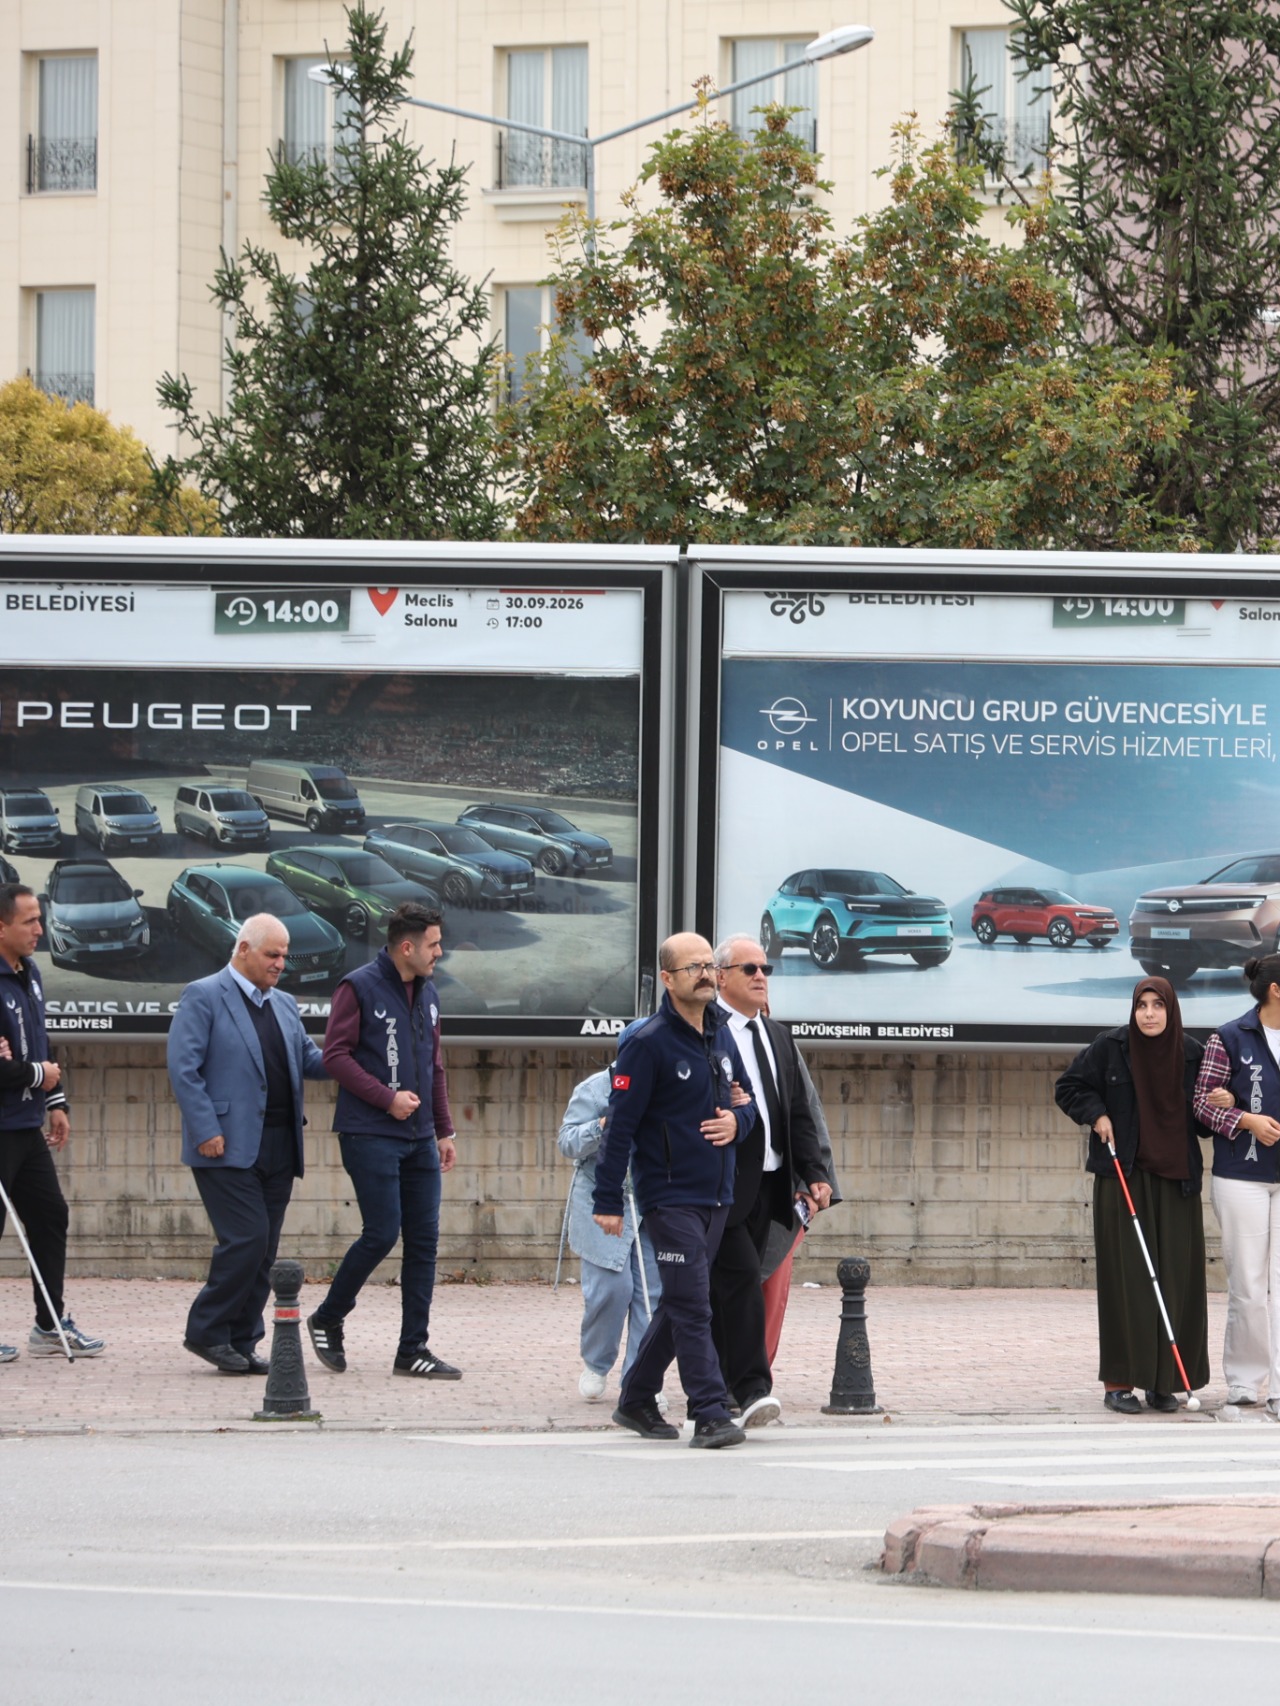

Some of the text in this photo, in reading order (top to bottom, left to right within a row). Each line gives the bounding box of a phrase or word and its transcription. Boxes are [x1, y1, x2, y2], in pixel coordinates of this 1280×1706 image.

[6, 591, 134, 612] BELEDİYESİ
[405, 594, 454, 607] Meclis
[505, 597, 584, 610] 30.09.2026
[1101, 599, 1174, 616] 14:00
[263, 599, 339, 623] 14:00
[404, 614, 457, 628] Salonu
[505, 616, 542, 628] 17:00
[17, 701, 311, 731] PEUGEOT
[842, 695, 1267, 725] KOYUNCU GRUP GÜVENCESİYLE
[757, 741, 818, 751] OPEL
[841, 732, 907, 753] OPEL
[913, 732, 985, 759] SATIŞ
[992, 734, 1023, 755] VE
[1030, 730, 1116, 757] SERVİS
[1123, 731, 1276, 763] HİZMETLERİ,
[44, 1016, 112, 1029] ELEDİYESİ
[792, 1023, 954, 1038] BÜYÜKŞEHİR BELEDİYESİ
[386, 1018, 401, 1092] ZABIT
[658, 1251, 685, 1263] ZABITA
